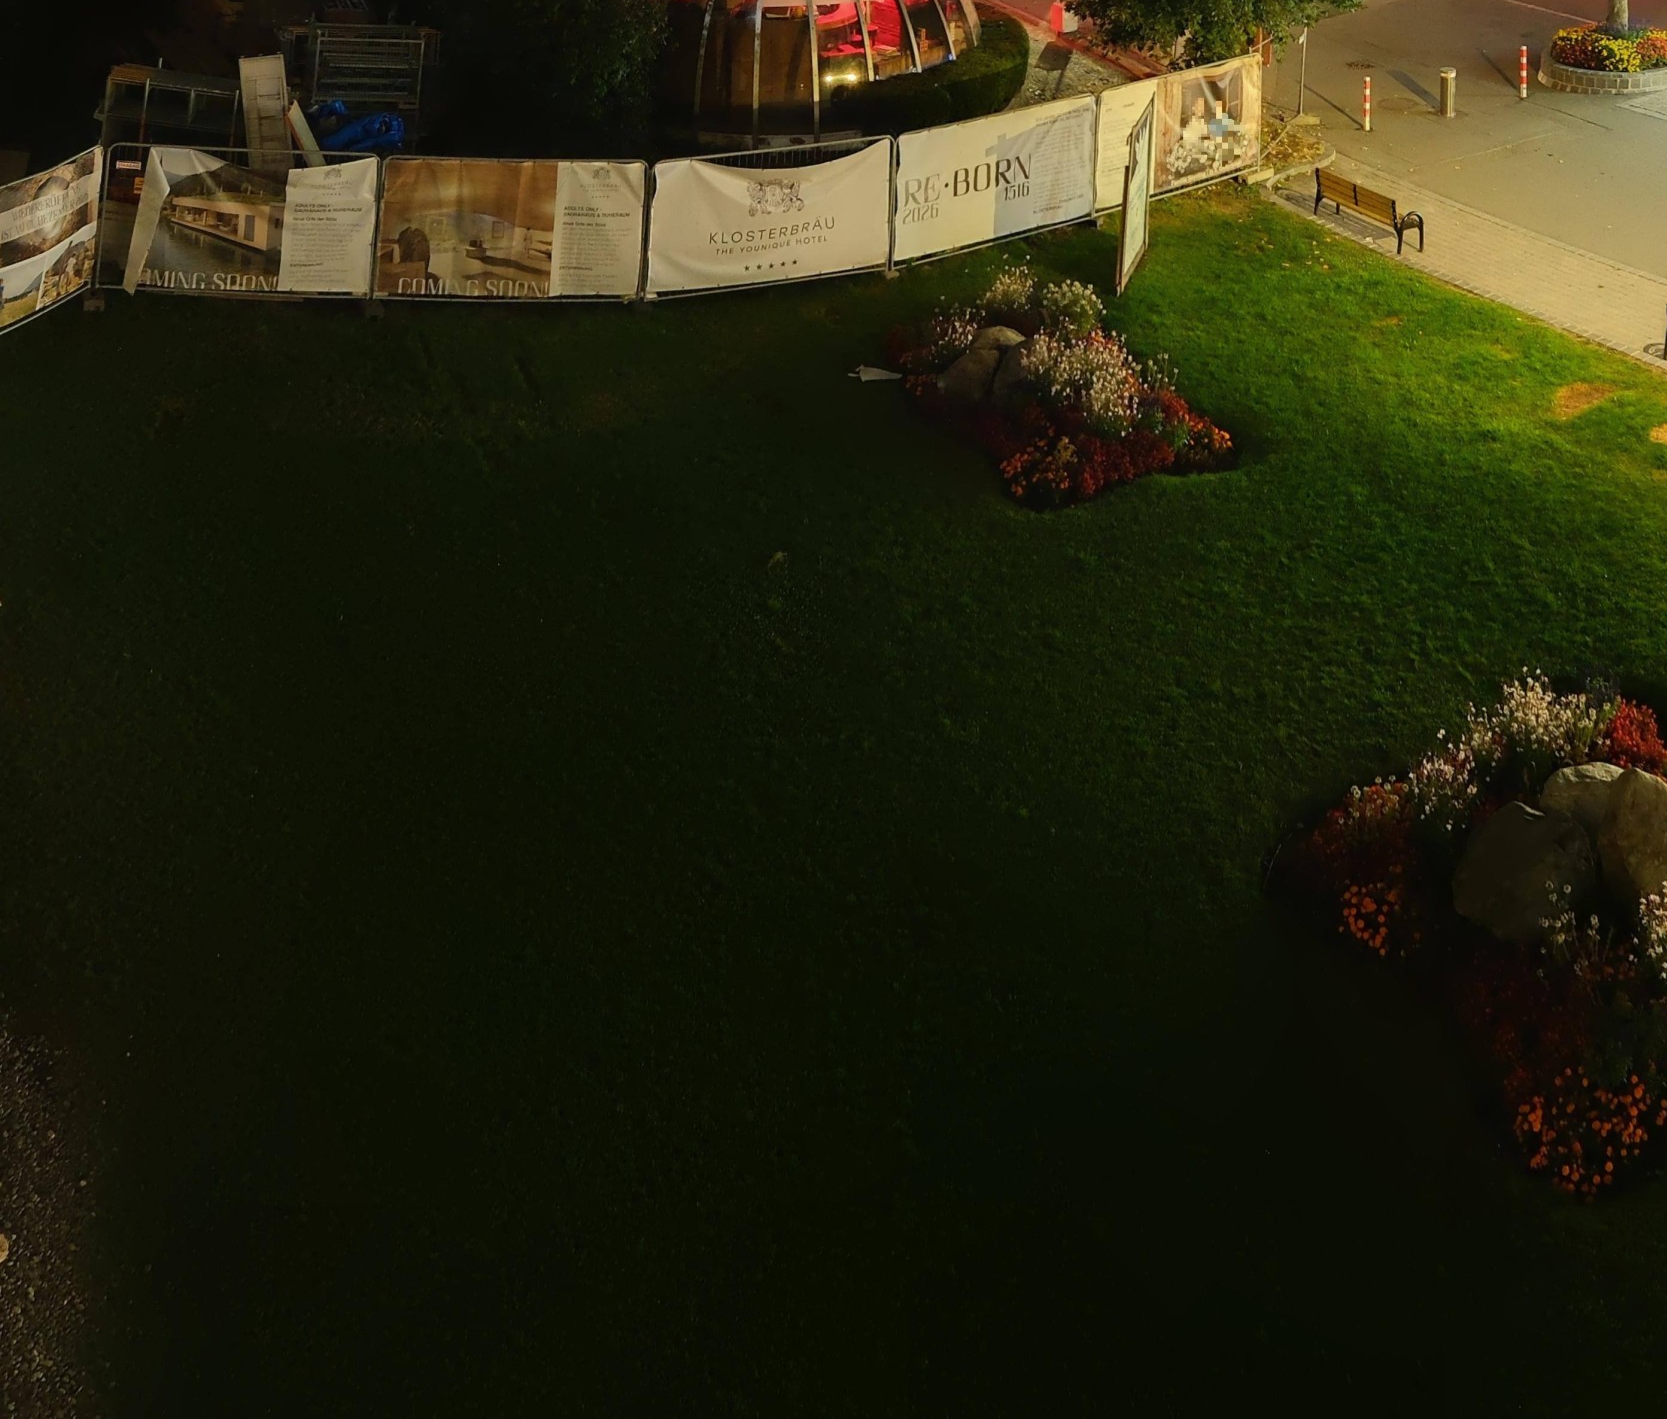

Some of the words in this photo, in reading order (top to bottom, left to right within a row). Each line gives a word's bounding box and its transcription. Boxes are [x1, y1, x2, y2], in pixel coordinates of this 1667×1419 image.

[1004, 180, 1030, 201] 1516
[709, 215, 835, 244] KLOSTERBRÄU
[740, 239, 791, 253] YOUNIQUE
[796, 235, 828, 245] HOTEL
[139, 268, 205, 289] OMING
